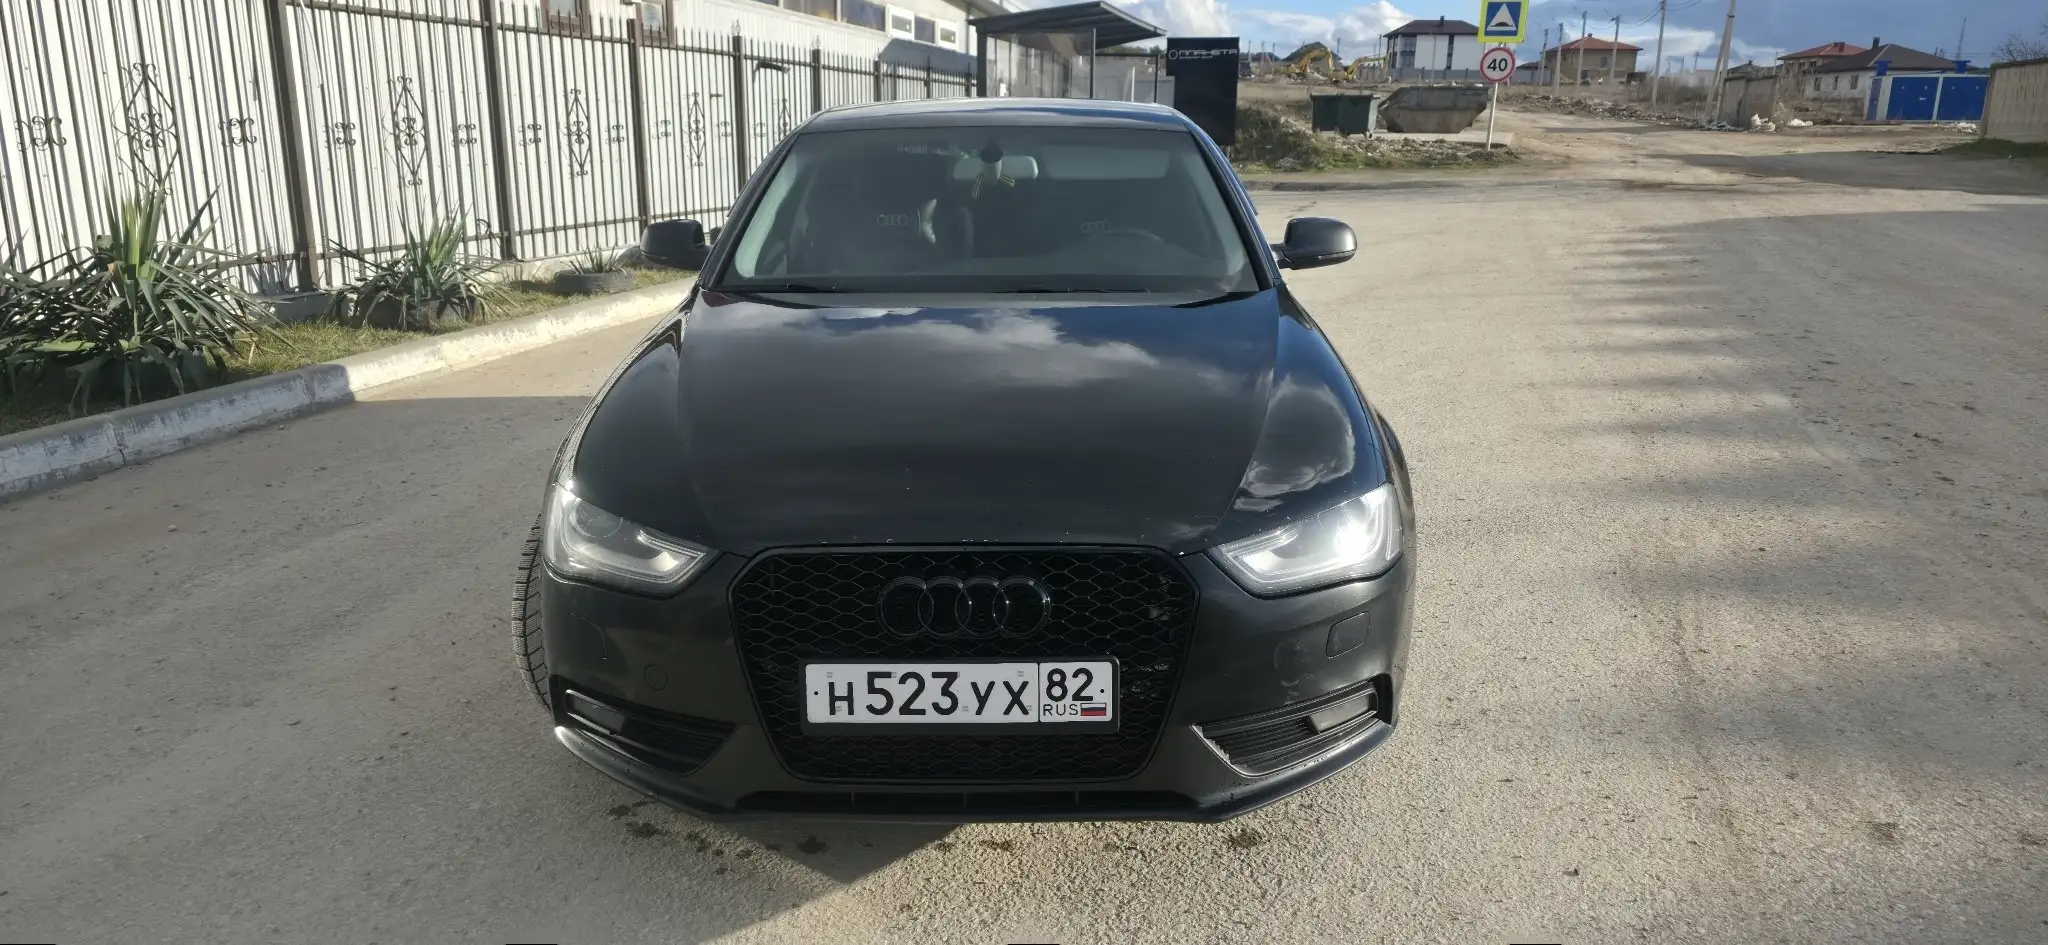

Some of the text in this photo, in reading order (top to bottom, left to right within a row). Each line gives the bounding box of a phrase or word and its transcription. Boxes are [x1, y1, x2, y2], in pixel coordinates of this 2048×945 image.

[1487, 58, 1508, 72] 40
[1045, 667, 1094, 702] 82
[1042, 703, 1079, 717] RUS
